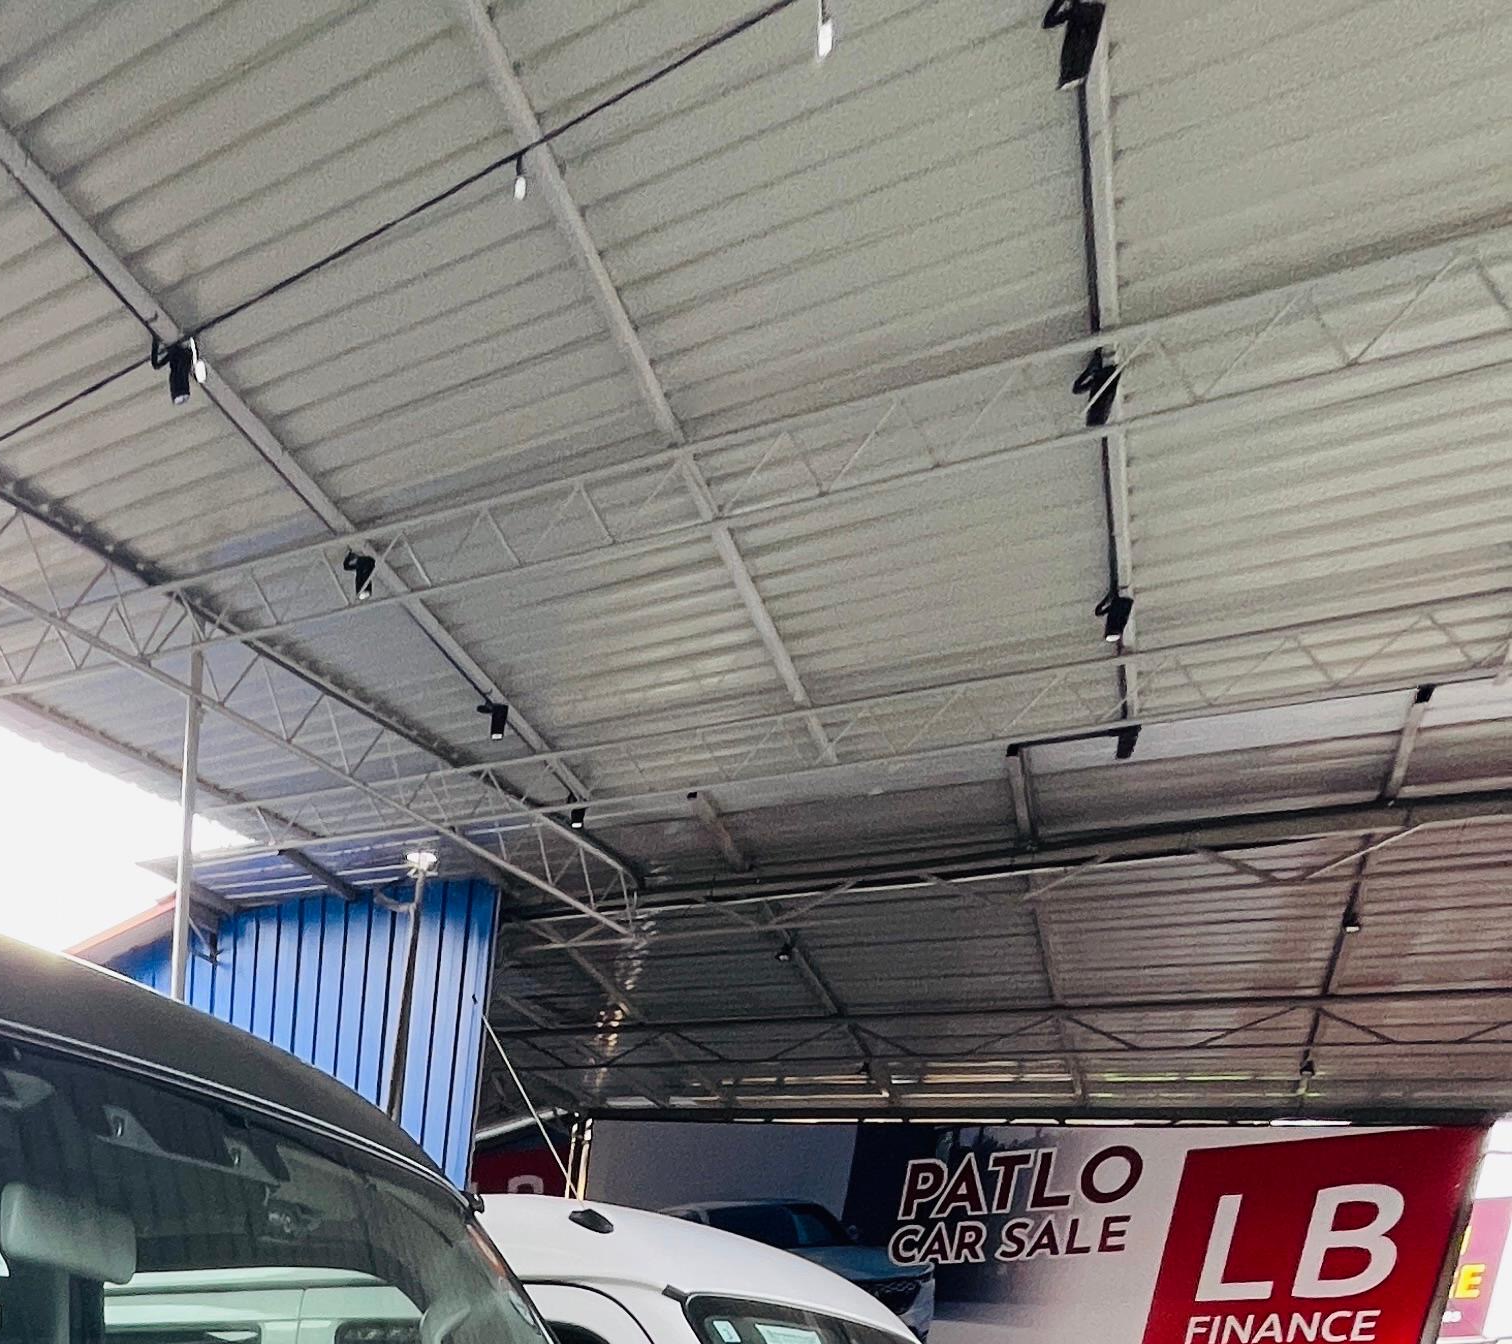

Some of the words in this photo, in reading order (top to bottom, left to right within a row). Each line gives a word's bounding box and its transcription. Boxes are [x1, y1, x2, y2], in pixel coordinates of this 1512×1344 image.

[896, 1145, 1145, 1220] PATLO
[890, 1221, 986, 1266] CAR
[995, 1215, 1132, 1262] SALE
